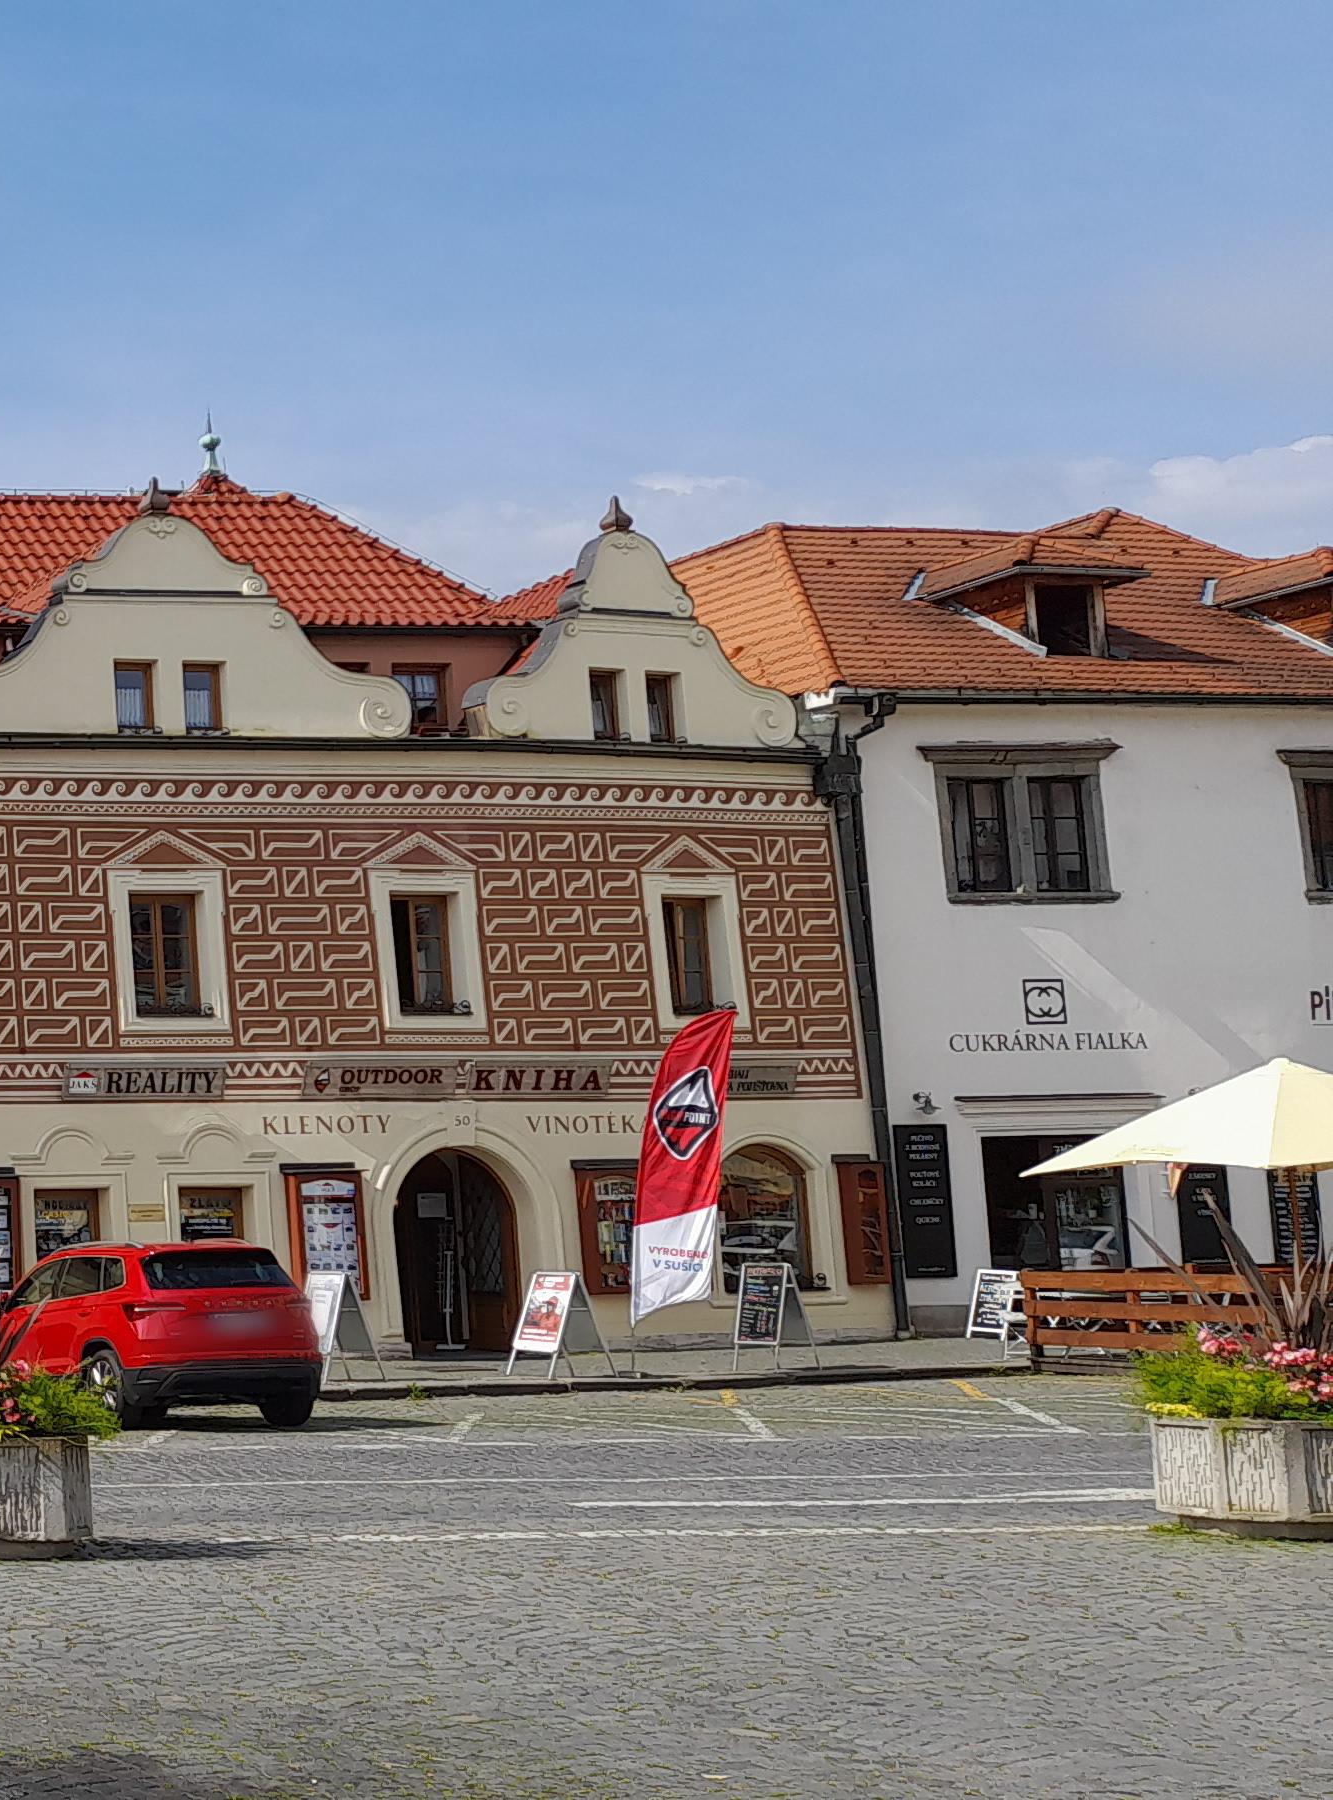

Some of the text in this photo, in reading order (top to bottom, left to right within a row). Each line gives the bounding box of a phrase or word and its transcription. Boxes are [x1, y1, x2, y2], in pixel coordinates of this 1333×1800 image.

[949, 1029, 1148, 1053] CUKRÁRNA FIALKA
[69, 1079, 97, 1089] JAKS
[105, 1071, 219, 1094] REALITY
[340, 1068, 443, 1085] OUTDOOR
[472, 1069, 602, 1091] KNIHA
[263, 1114, 391, 1135] KLENOTY
[454, 1115, 471, 1127] 50
[684, 1112, 712, 1125] POINT
[648, 1246, 709, 1259] VYROBENO
[653, 1259, 661, 1268] V
